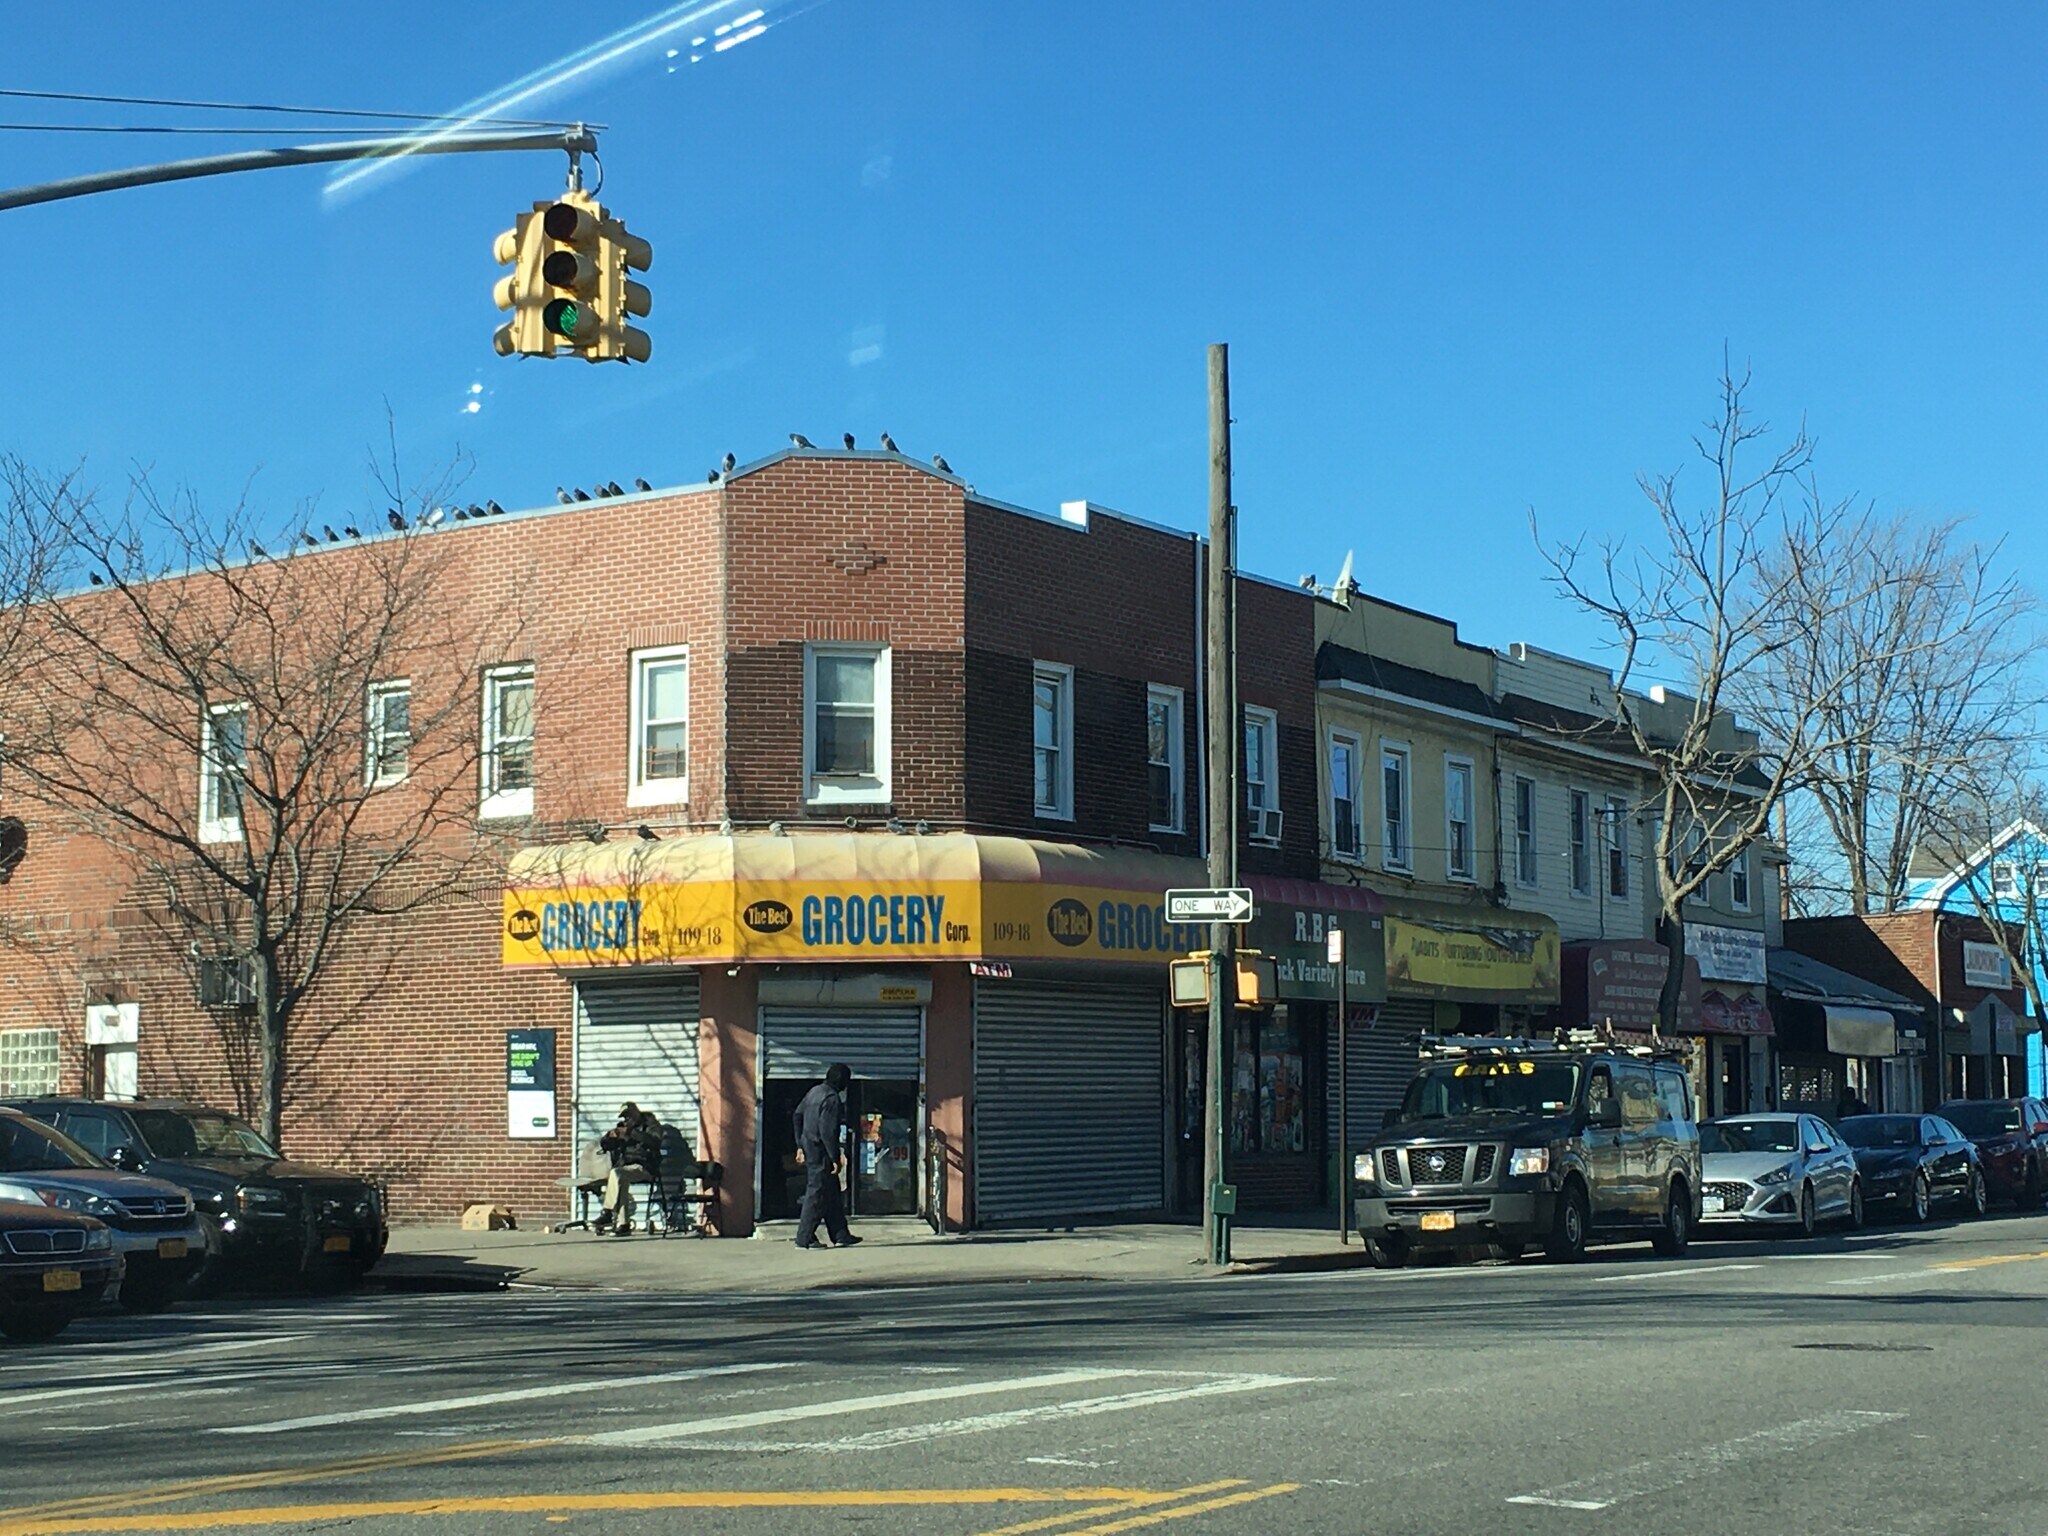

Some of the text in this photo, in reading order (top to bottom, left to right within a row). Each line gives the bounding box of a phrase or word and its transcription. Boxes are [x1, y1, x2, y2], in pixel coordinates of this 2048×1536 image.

[1175, 899, 1239, 912] ONE WAY
[542, 899, 642, 952] GROCERY
[748, 894, 971, 947] The Best GROCERY Corp.
[993, 922, 1031, 942] 109-18
[1052, 907, 1069, 936] The
[1069, 909, 1089, 936] Best
[677, 926, 722, 946] 109-18
[975, 963, 1010, 977] ATM
[1296, 959, 1336, 989] Variety
